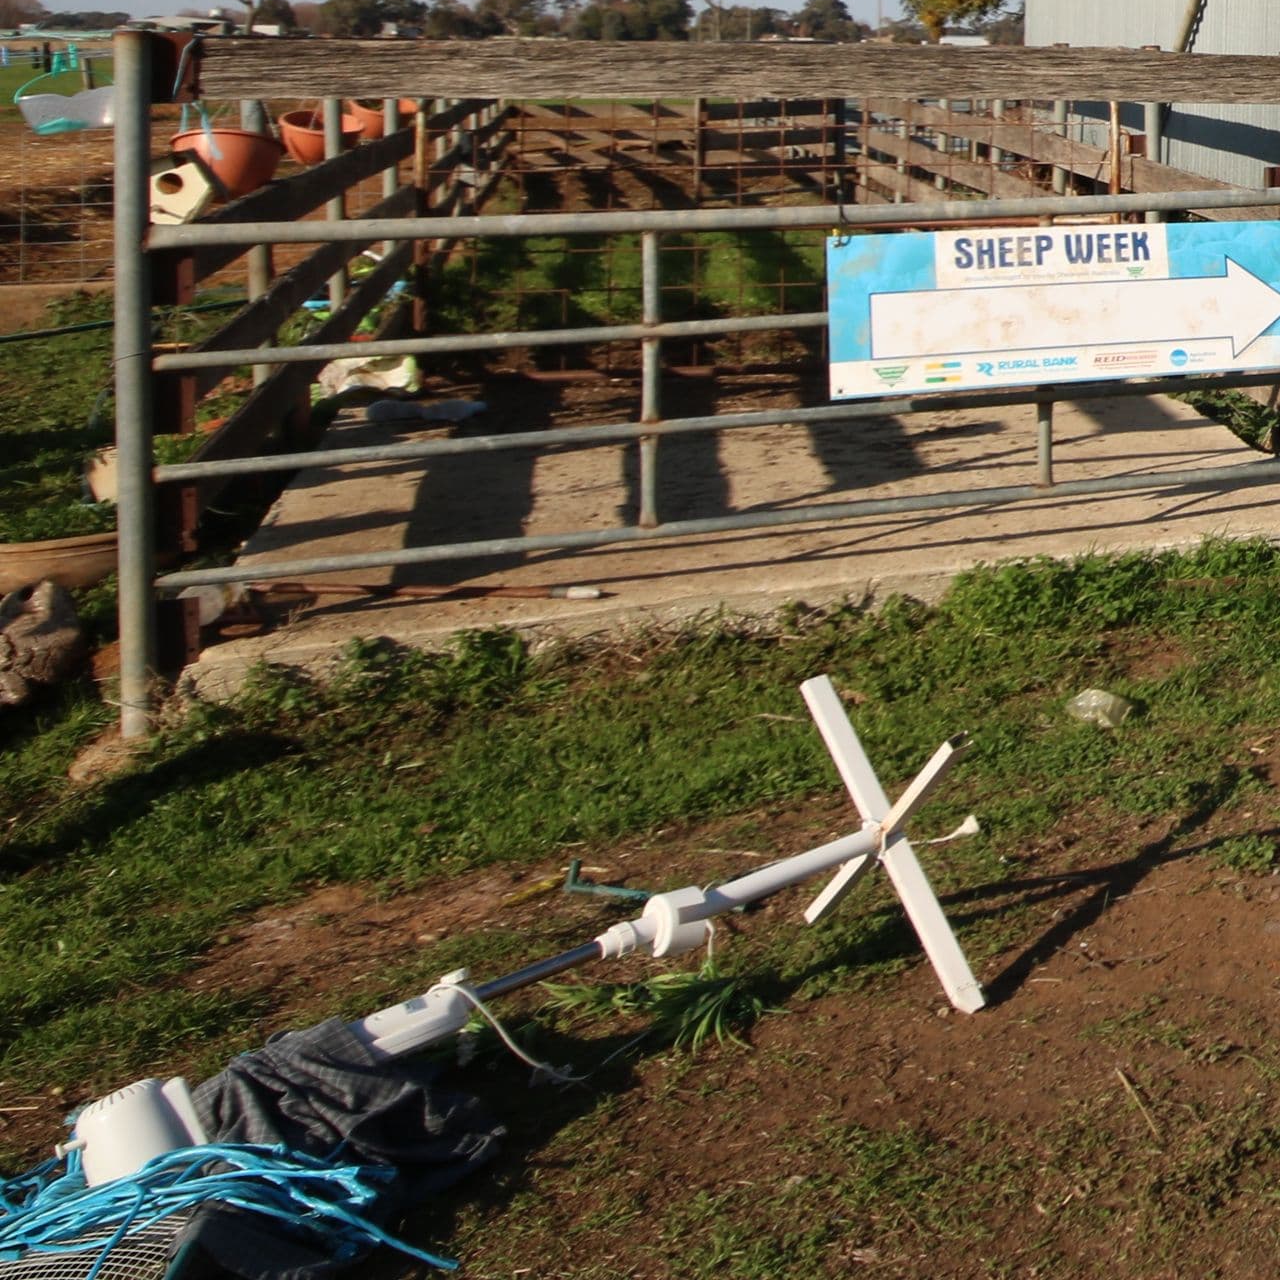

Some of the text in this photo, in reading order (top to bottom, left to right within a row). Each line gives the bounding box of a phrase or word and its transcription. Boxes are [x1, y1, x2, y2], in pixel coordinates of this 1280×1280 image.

[954, 232, 1150, 269] SHEEP WEEK
[998, 356, 1078, 370] RURAL BANK
[1094, 355, 1126, 363] REID
